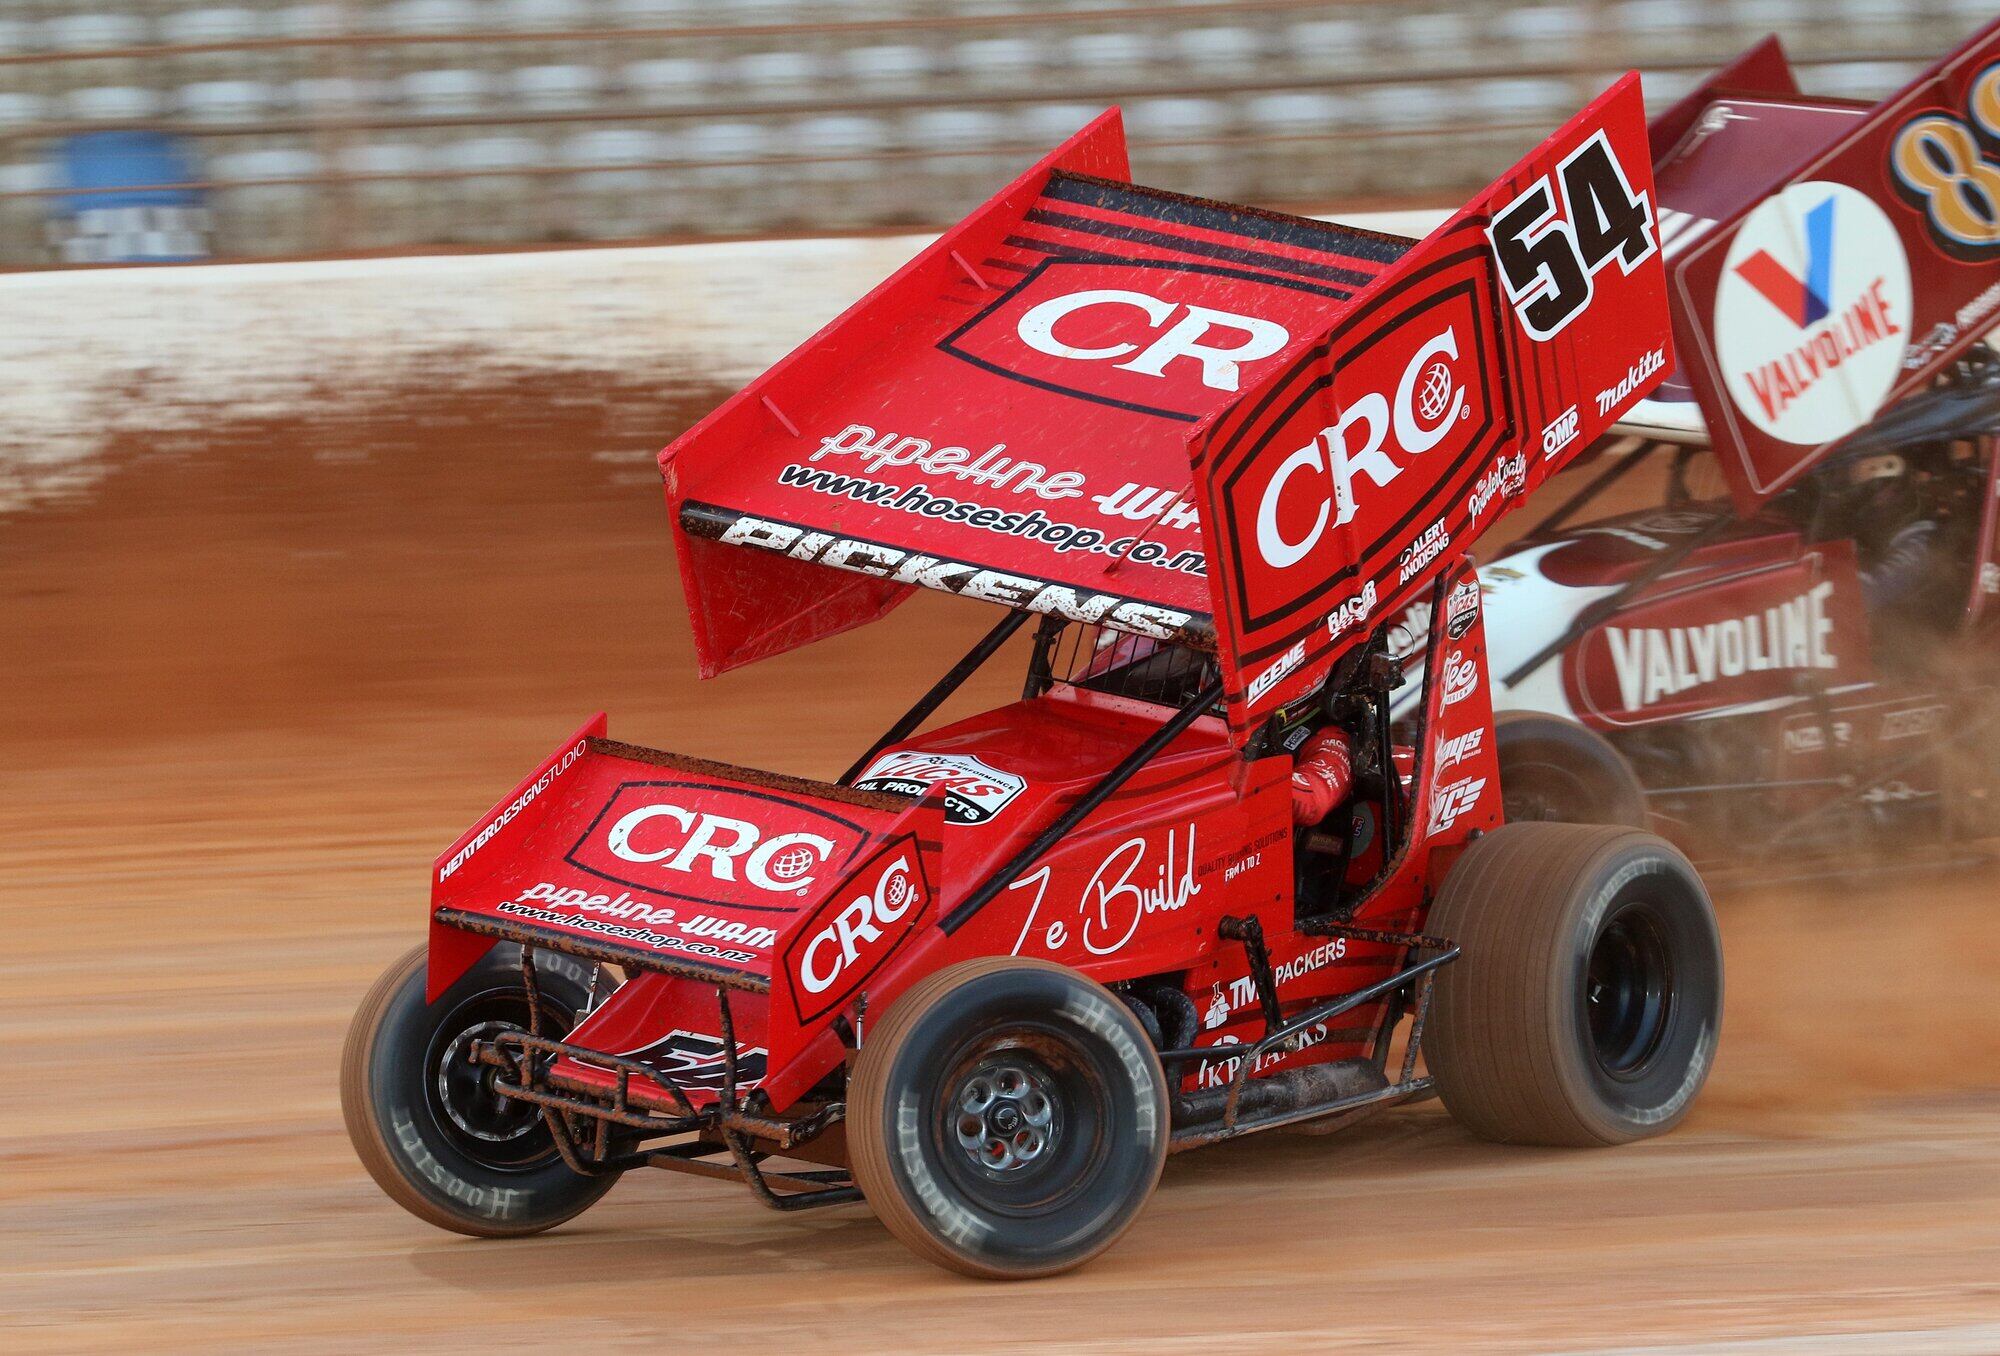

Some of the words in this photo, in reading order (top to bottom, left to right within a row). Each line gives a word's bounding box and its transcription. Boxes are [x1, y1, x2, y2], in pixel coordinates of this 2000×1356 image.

[1485, 128, 1658, 342] 54
[1744, 276, 1903, 423] VALVOLINE
[1256, 325, 1466, 569] CRC
[1542, 408, 1579, 456] OMP
[1400, 533, 1449, 585] ANODISING
[1412, 517, 1445, 554] ALERT
[720, 516, 1191, 639] PICKENS
[1243, 638, 1306, 706] KEENE
[1605, 581, 1838, 712] VALVOLINE
[882, 781, 980, 820] PROCTS
[607, 805, 837, 892] CRC
[1247, 856, 1255, 870] TO
[1256, 852, 1261, 866] Z
[800, 855, 912, 994] CRC
[1079, 822, 1201, 955] Build
[495, 900, 757, 963] www.hoseshop.co.nz
[1275, 937, 1346, 987] PACKERS
